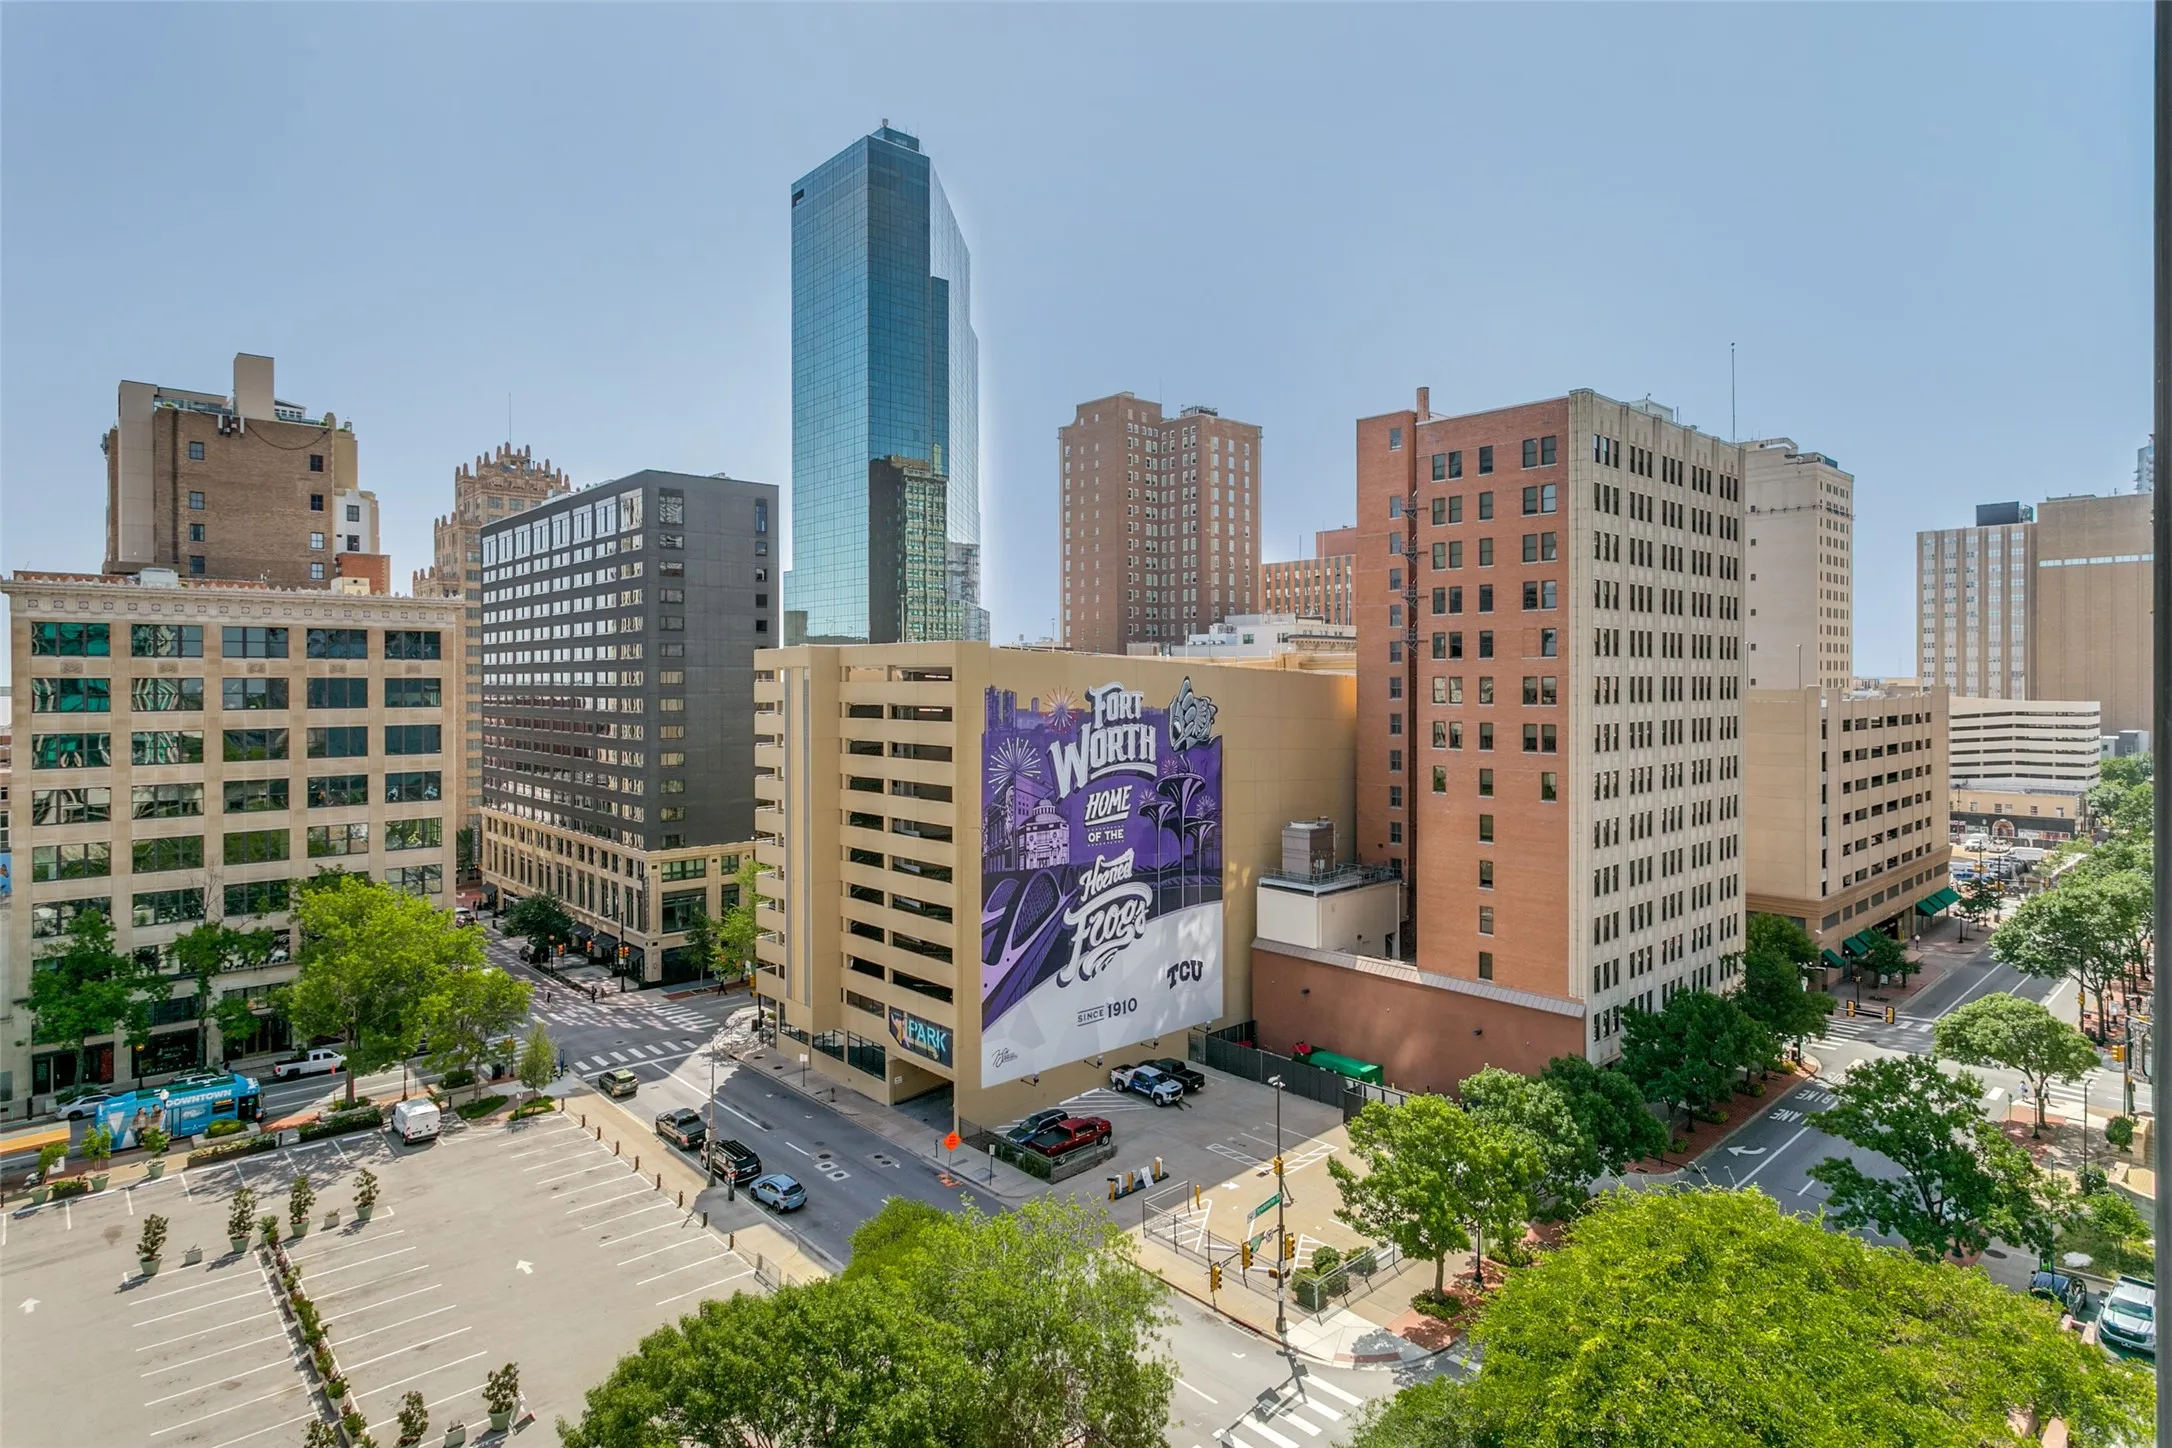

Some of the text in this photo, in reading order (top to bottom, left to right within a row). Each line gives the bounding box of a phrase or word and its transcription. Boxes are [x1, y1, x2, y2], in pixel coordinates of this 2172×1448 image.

[1086, 785, 1133, 820] HOME
[1088, 830, 1124, 842] OF THE
[1166, 960, 1203, 989] TCU
[1077, 997, 1138, 1023] SINCE 1910
[908, 1020, 947, 1052] PARK
[166, 1089, 232, 1106] DOWNTOWN
[1794, 1089, 1836, 1104] BIKE
